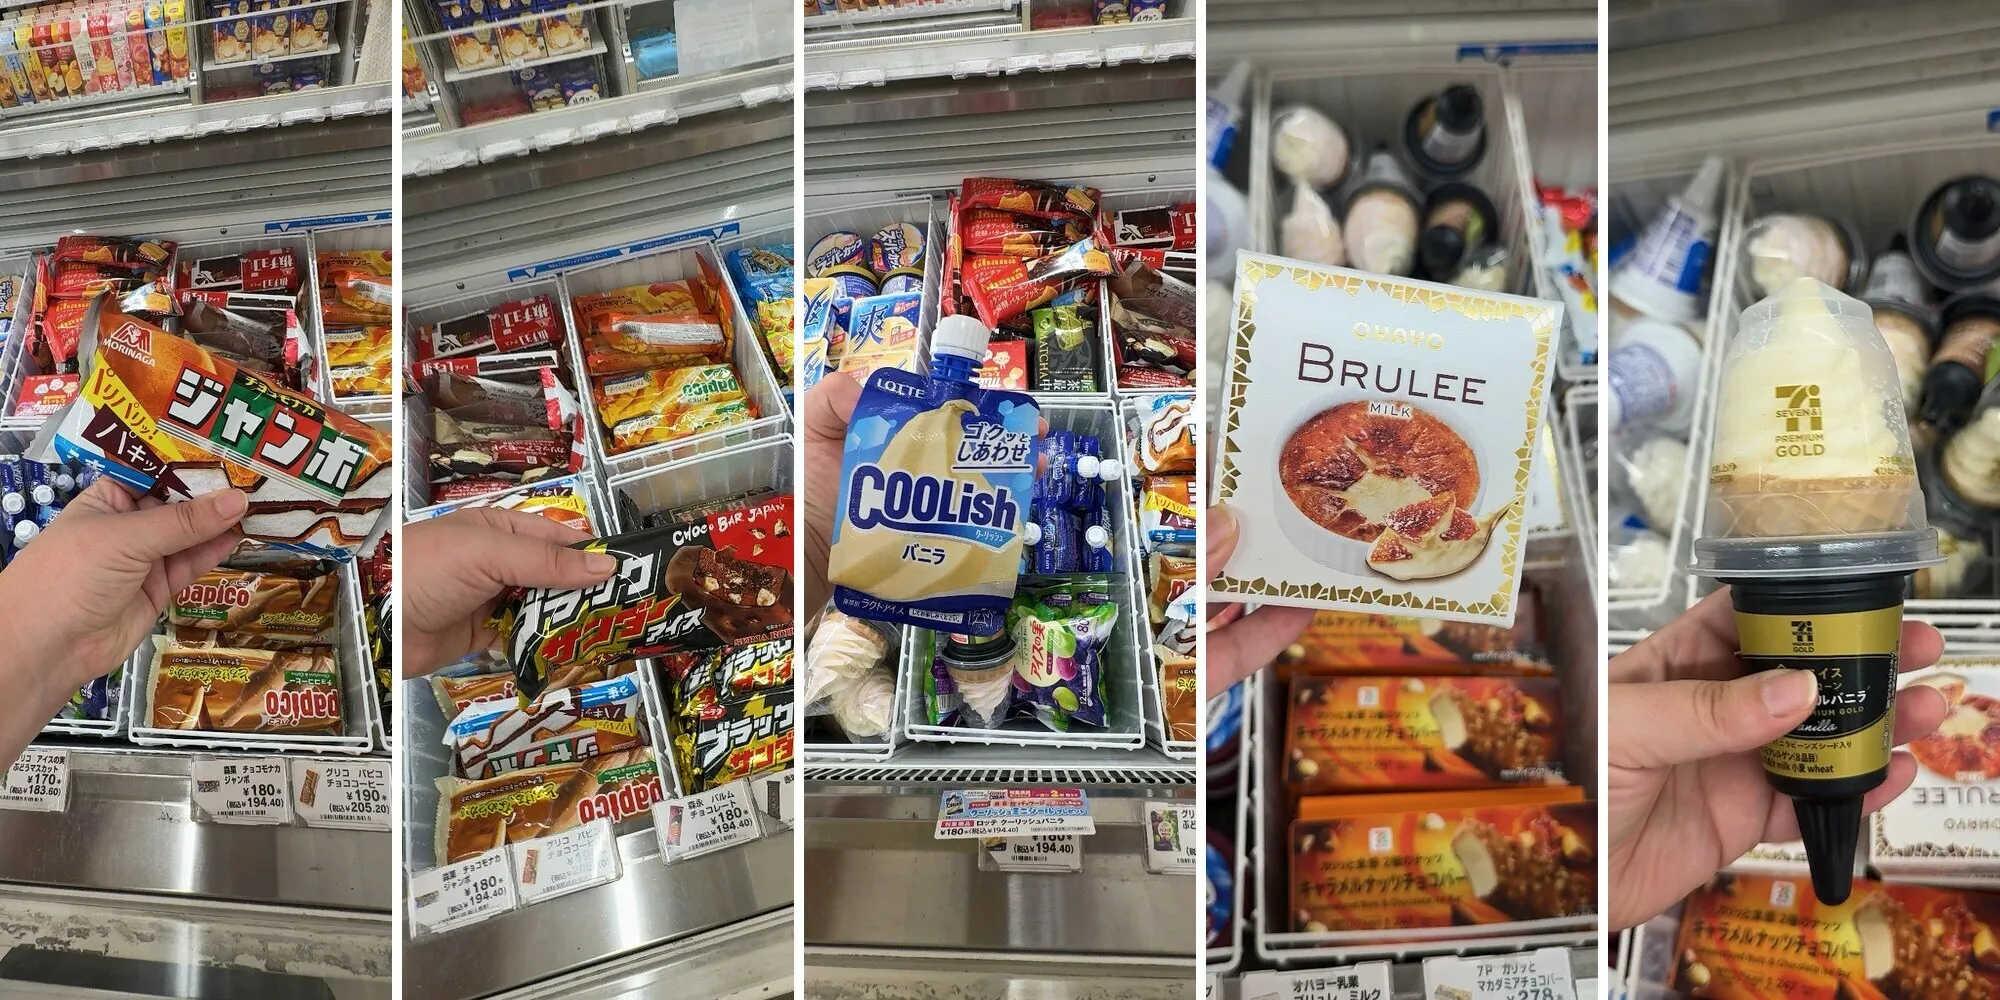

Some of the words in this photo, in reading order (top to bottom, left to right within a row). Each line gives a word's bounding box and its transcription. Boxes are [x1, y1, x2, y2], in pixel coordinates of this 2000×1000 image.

[972, 256, 1017, 270] Ghana
[853, 304, 890, 353] 爽
[1351, 321, 1445, 351] OHAYO
[103, 337, 156, 367] MORINAGA
[1039, 330, 1049, 379] MATCHA
[1296, 342, 1485, 406] BRULEE
[245, 376, 317, 417] チョコモナカ
[877, 379, 926, 400] LOTTE
[1369, 402, 1410, 418] MILK
[168, 368, 366, 491] ジャンボ
[964, 422, 1029, 442] ゴクッと
[1775, 433, 1825, 443] PREMIUM
[96, 422, 168, 479] パキッ!
[956, 441, 1028, 463] しあわせ
[1776, 443, 1826, 458] GOLD
[848, 464, 1018, 531] COOLish
[672, 513, 714, 547] CHOCO
[716, 511, 744, 533] BAR
[747, 502, 786, 524] JAPAN
[974, 530, 1004, 543] クーリッシュ
[902, 543, 947, 566] バニラ
[176, 579, 250, 607] papico
[180, 607, 224, 616] チョココーヒー
[861, 598, 905, 616] ラクトアイス
[645, 607, 707, 646] アイス
[1030, 620, 1047, 681] アイスの実
[1793, 646, 1815, 654] GOLD
[265, 690, 340, 724] papico
[1839, 705, 1865, 718] GOLD
[13, 763, 58, 773] ぶどうマスカット
[36, 755, 65, 764] アイスの実
[1807, 764, 1834, 773] wheat
[243, 765, 281, 775] チョコモナカ
[325, 769, 350, 780] グリコ
[224, 775, 251, 785] ジャンボ
[327, 781, 385, 791] チョココーヒー
[226, 797, 285, 810] (税込¥194.40)
[578, 779, 663, 824] papico
[711, 791, 736, 804] パルム
[329, 802, 390, 815] (税込¥205.20)
[689, 799, 738, 820] チョコレート
[976, 819, 997, 827] ロッテ
[1001, 817, 1065, 827] クーリッシュバニラ
[546, 836, 570, 850] グリコ
[1013, 842, 1074, 856] (税込¥194.40)
[463, 855, 502, 875] チョコモナカ
[443, 874, 472, 892] ジャンボ
[1694, 921, 1863, 961] キャラメルナッツチョコバー
[1477, 972, 1564, 992] マカダミアチョコバー
